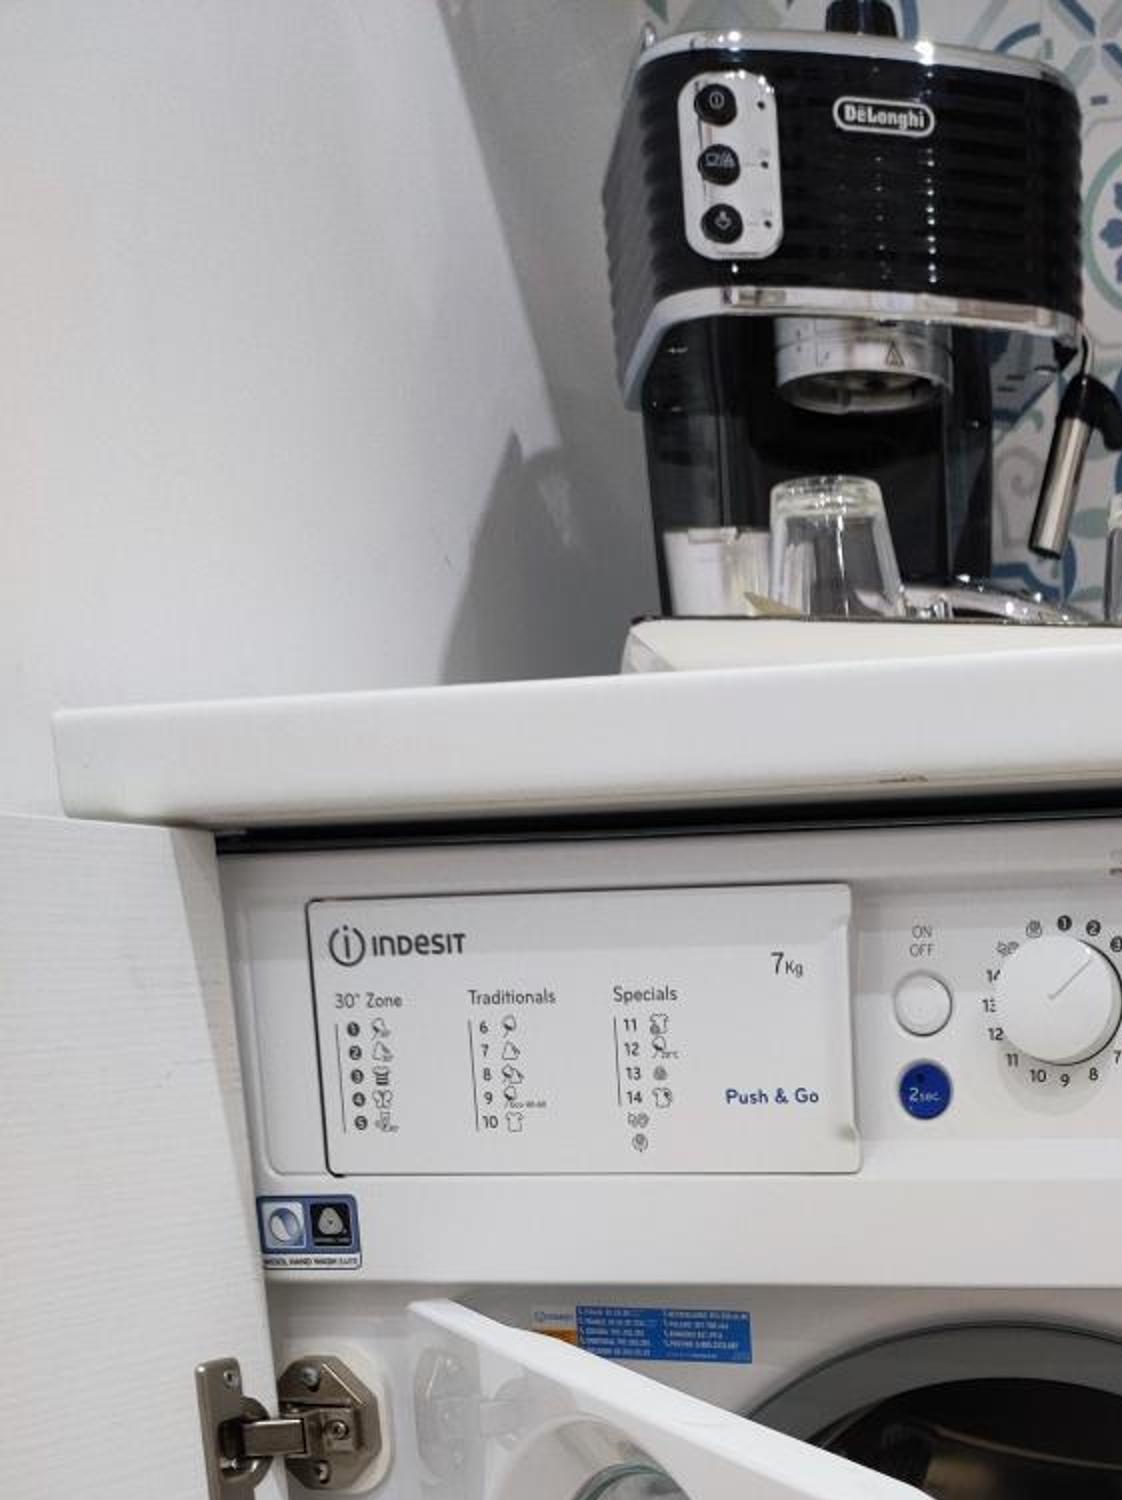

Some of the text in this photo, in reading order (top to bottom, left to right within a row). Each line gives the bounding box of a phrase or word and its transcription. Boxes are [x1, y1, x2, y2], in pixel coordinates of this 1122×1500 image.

[912, 925, 932, 938] ON
[910, 944, 935, 957] OFF
[366, 992, 404, 1008] Zone
[467, 988, 557, 1005] Traditionals
[613, 985, 678, 1004] Specials
[479, 1021, 489, 1034] 6
[624, 1018, 637, 1031] 11
[988, 1027, 1004, 1041] 12
[480, 1044, 489, 1057] 7
[624, 1042, 640, 1056] 12
[1005, 1053, 1019, 1067] 11
[1113, 1049, 1122, 1065] 7
[482, 1068, 492, 1081] 8
[625, 1067, 641, 1080] 13
[1030, 1069, 1047, 1082] 10
[1089, 1067, 1099, 1081] 8
[1060, 1074, 1070, 1087] 9
[484, 1092, 494, 1104] 9
[626, 1091, 643, 1104] 14
[725, 1087, 820, 1104] Push & Go
[482, 1116, 499, 1129] 10
